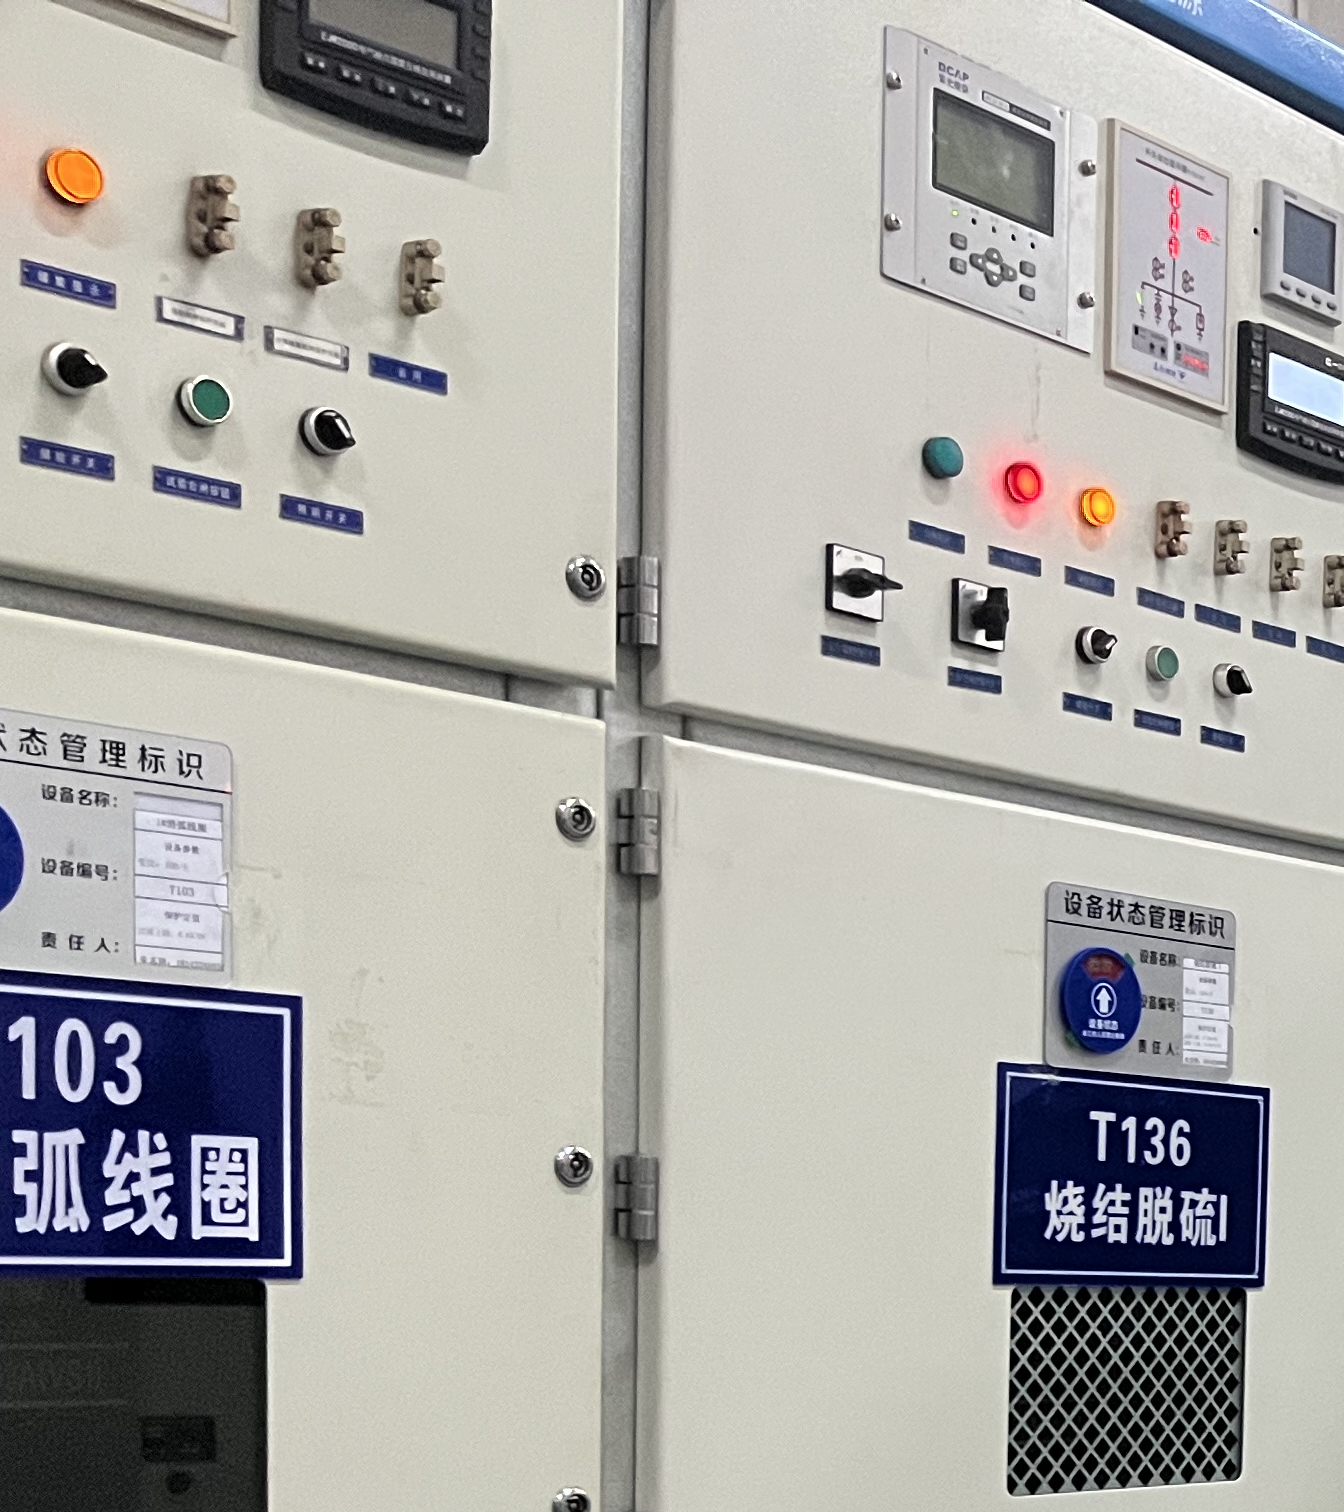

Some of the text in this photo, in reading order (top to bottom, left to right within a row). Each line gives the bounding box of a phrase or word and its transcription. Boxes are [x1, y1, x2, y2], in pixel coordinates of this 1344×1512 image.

[0, 722, 204, 781] 态管理标识
[169, 884, 195, 897] T103
[1064, 889, 1226, 940] 设备状态管理标识
[8, 1015, 143, 1106] 103
[1089, 1110, 1192, 1167] T136
[11, 1127, 260, 1242] 弧线圈
[1044, 1179, 1228, 1247] 烧结脱硫I
